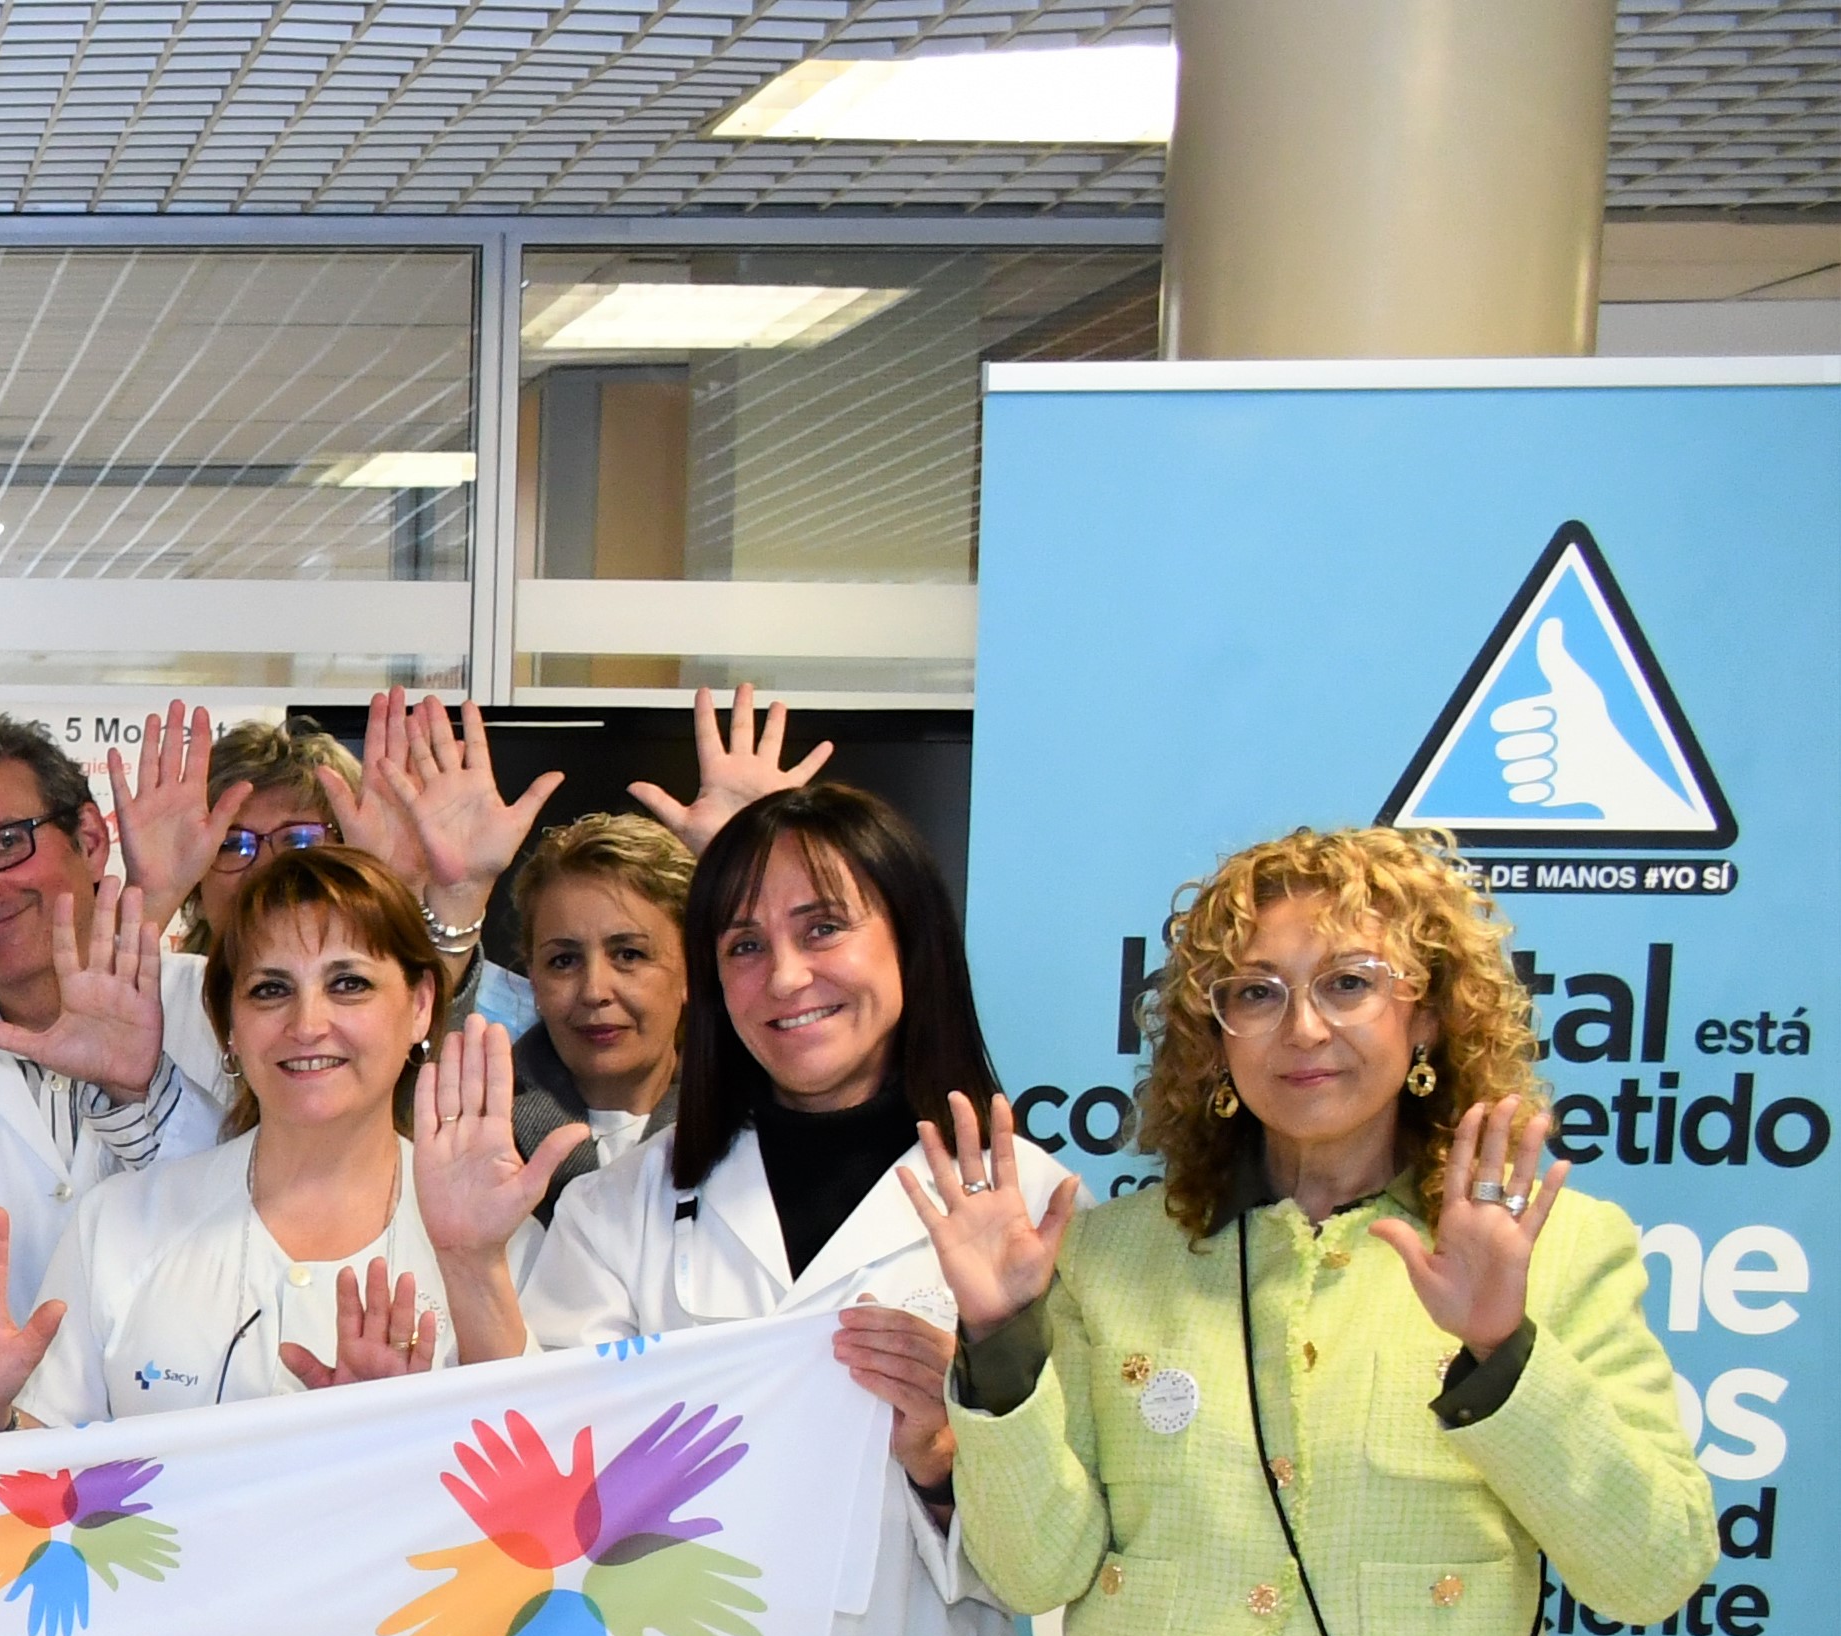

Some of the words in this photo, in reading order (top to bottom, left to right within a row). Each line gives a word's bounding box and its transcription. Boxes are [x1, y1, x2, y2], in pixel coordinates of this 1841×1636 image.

[65, 717, 82, 742] 5
[1491, 865, 1529, 888] DE
[1536, 865, 1636, 889] MANOS
[1643, 865, 1695, 889] #YO
[1702, 862, 1732, 889] SÍ
[1695, 1005, 1811, 1055] está
[163, 1368, 199, 1387] Sacyl
